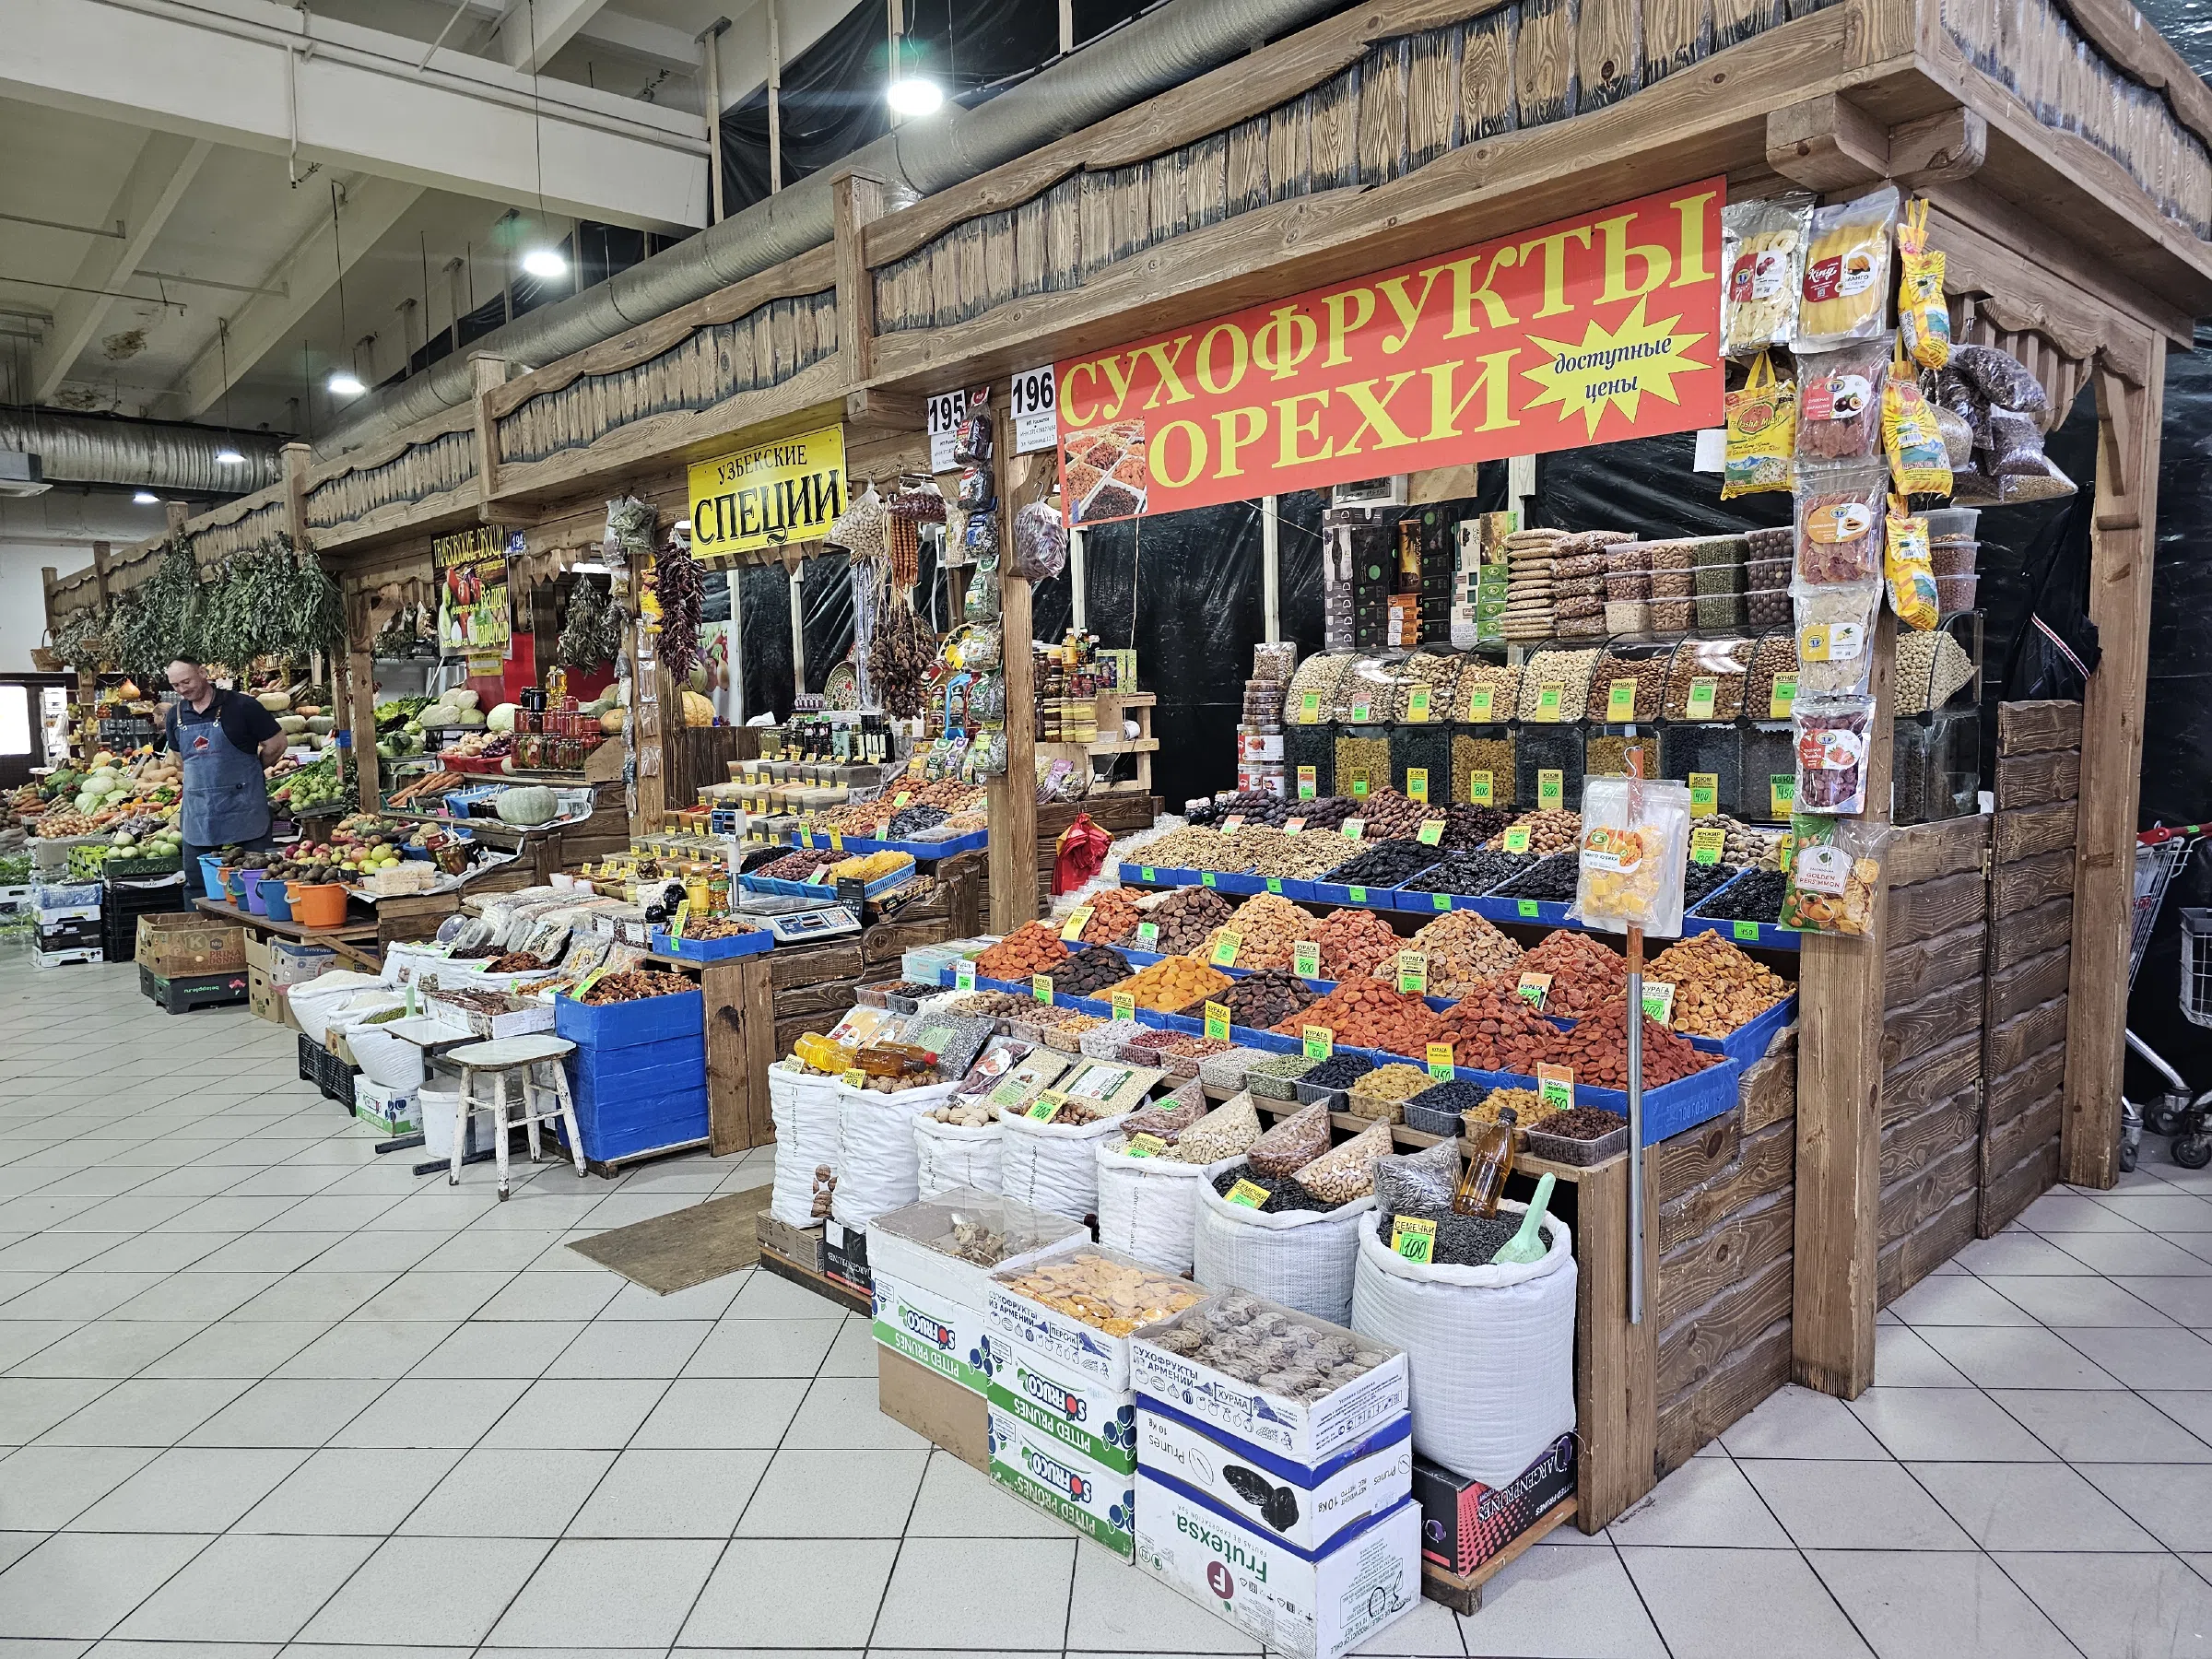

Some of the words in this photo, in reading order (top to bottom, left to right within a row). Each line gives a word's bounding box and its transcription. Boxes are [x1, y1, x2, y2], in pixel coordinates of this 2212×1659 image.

[1060, 191, 1717, 428] СУХОФРУКТЫ
[1555, 334, 1672, 376] доступные
[1012, 371, 1053, 415] 196
[1585, 374, 1639, 402] цены
[929, 393, 964, 432] 195
[1149, 348, 1522, 488] ОРЕХИ
[717, 444, 807, 485] УЗБЕКСКИЕ
[694, 468, 841, 547] СПЕЦИИ
[477, 524, 504, 559] ОВОЩИ
[512, 535, 524, 549] 194
[480, 583, 508, 610] Вадим
[1771, 775, 1796, 784] ИЗЮМ
[1475, 786, 1488, 796] 800
[1542, 786, 1559, 797] 500
[1694, 792, 1709, 802] 400
[1777, 788, 1794, 799] 450
[1799, 877, 1841, 888] PERSIMMON
[1806, 872, 1837, 881] GOLDEN
[1740, 927, 1753, 935] 450
[210, 949, 241, 959] PRIMA
[1293, 944, 1317, 954] КУРАГА
[1401, 954, 1425, 963] КУРАГА
[208, 957, 243, 965] DONNA
[1299, 961, 1315, 974] 800
[183, 985, 220, 994] belapple.ru
[1034, 978, 1051, 986] КУРАГА
[1520, 983, 1544, 993] КУРАГА
[1642, 984, 1671, 994] КУРАГА
[1113, 995, 1132, 1004] КУРАГА
[1207, 1006, 1228, 1017] КУРАГА
[1305, 1030, 1328, 1040] КУРАГА
[1312, 1048, 1324, 1059] 800
[1434, 1070, 1451, 1082] 450
[1033, 1105, 1052, 1120] 700
[1129, 1141, 1159, 1156] СЕМЕЧКИ
[1234, 1182, 1267, 1201] СЕМЕЧКИ
[1394, 1220, 1435, 1234] СЕМЕЧКИ
[1401, 1238, 1427, 1260] 100
[988, 1290, 1038, 1321] СУХОФРУКТЫ
[988, 1299, 998, 1310] ИЗ
[1000, 1303, 1034, 1328] АРМЕНИИ
[1051, 1325, 1077, 1346] ПЕРСИК
[895, 1332, 929, 1360] PRUNES
[931, 1353, 959, 1379] PITTED
[1133, 1345, 1199, 1382] СУХОФРУКТЫ
[1133, 1355, 1146, 1368] ИЗ
[1147, 1362, 1194, 1389] АРМЕНИИ
[1218, 1389, 1249, 1410] ХУРМА
[1014, 1397, 1054, 1434] PRUNES
[1059, 1421, 1091, 1454] PITTED
[1159, 1424, 1168, 1437] 10
[1148, 1435, 1185, 1464] Prunes
[1373, 1465, 1396, 1486] Prunes
[1017, 1476, 1059, 1513] PRUNES
[1477, 1455, 1556, 1524] ARGENPRUNES
[1535, 1495, 1558, 1516] PRUNES
[1061, 1504, 1096, 1536] PITTED
[1191, 1511, 1232, 1539] EXPORTACIÓN
[1176, 1512, 1268, 1584] Frutexsa
[1232, 1534, 1242, 1544] DE
[1244, 1541, 1268, 1558] FRUTAS
[1212, 1566, 1227, 1594] F
[1330, 1641, 1345, 1654] CHILE
